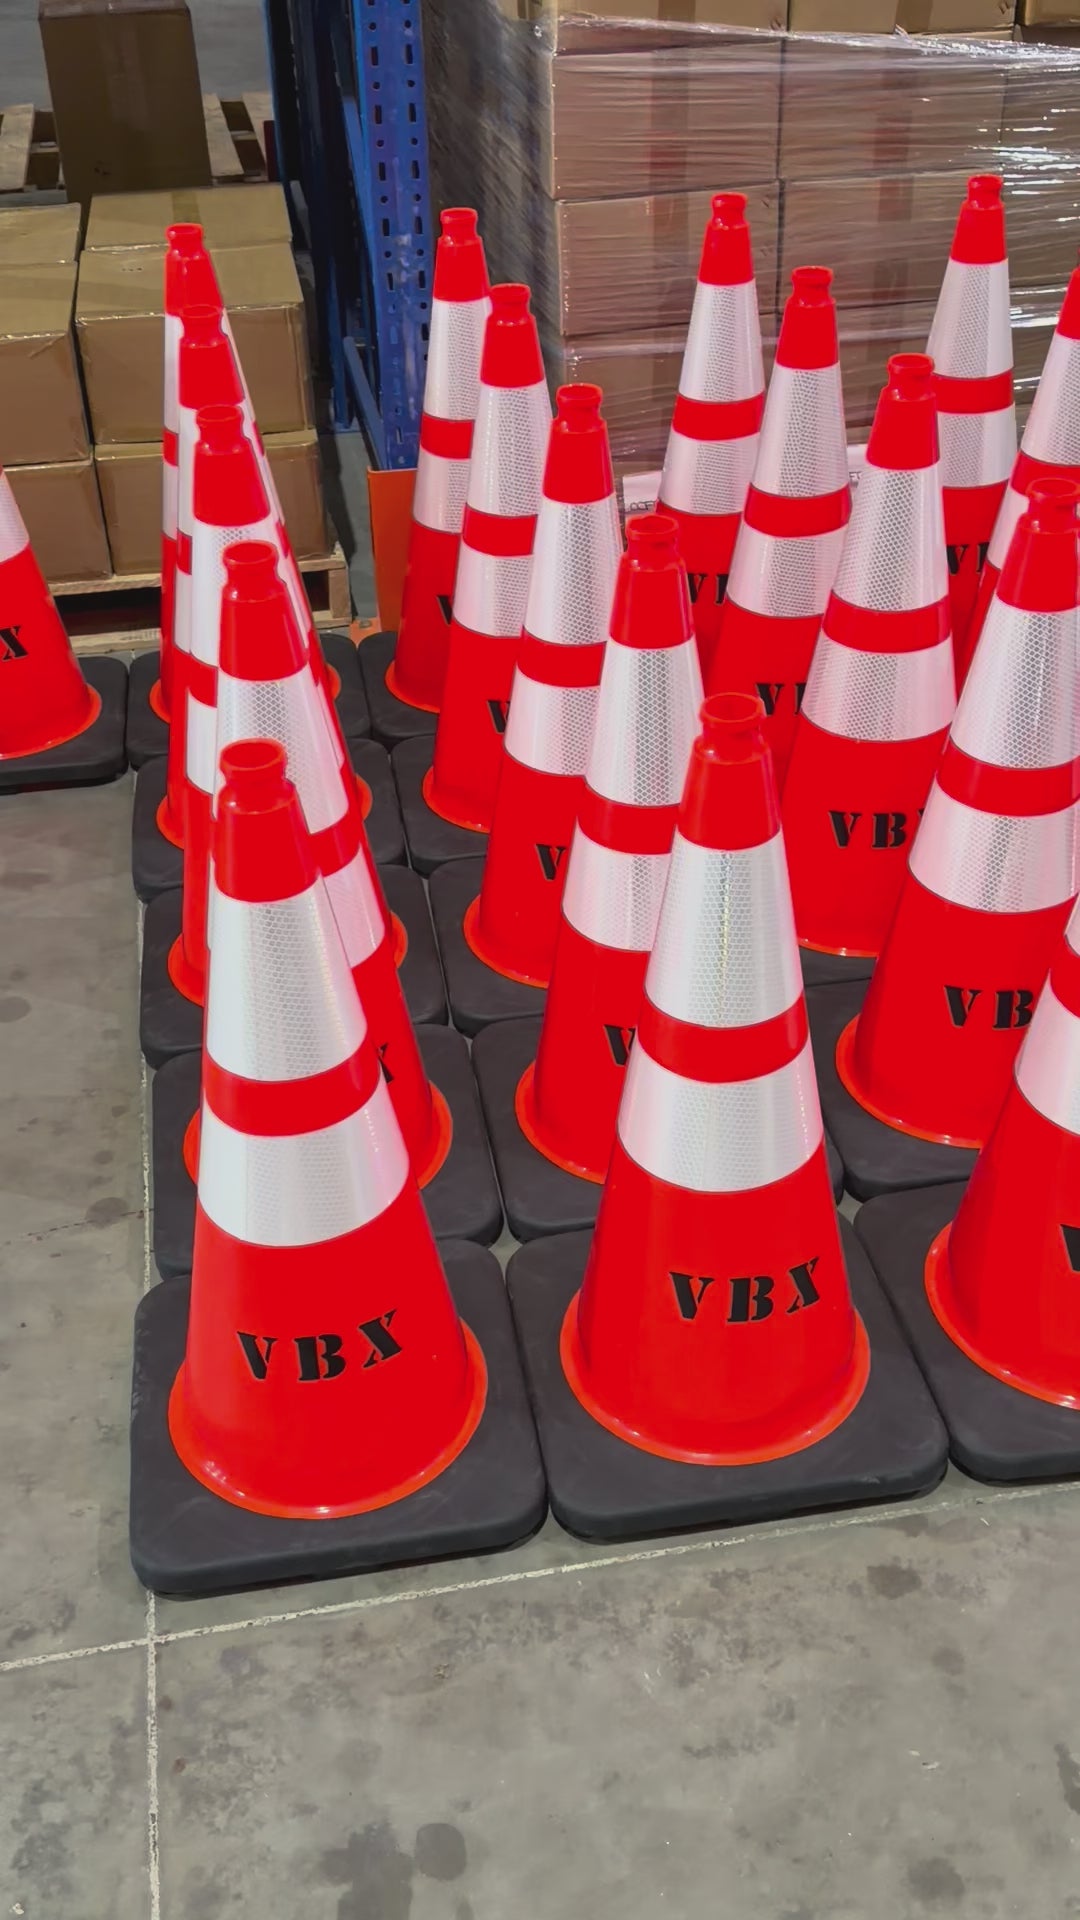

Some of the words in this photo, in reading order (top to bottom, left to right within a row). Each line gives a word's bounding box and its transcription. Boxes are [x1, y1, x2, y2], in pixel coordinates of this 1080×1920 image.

[829, 808, 924, 849] VB
[944, 985, 1034, 1030] VB
[669, 1256, 820, 1323] VBX
[237, 1309, 402, 1382] VBX
